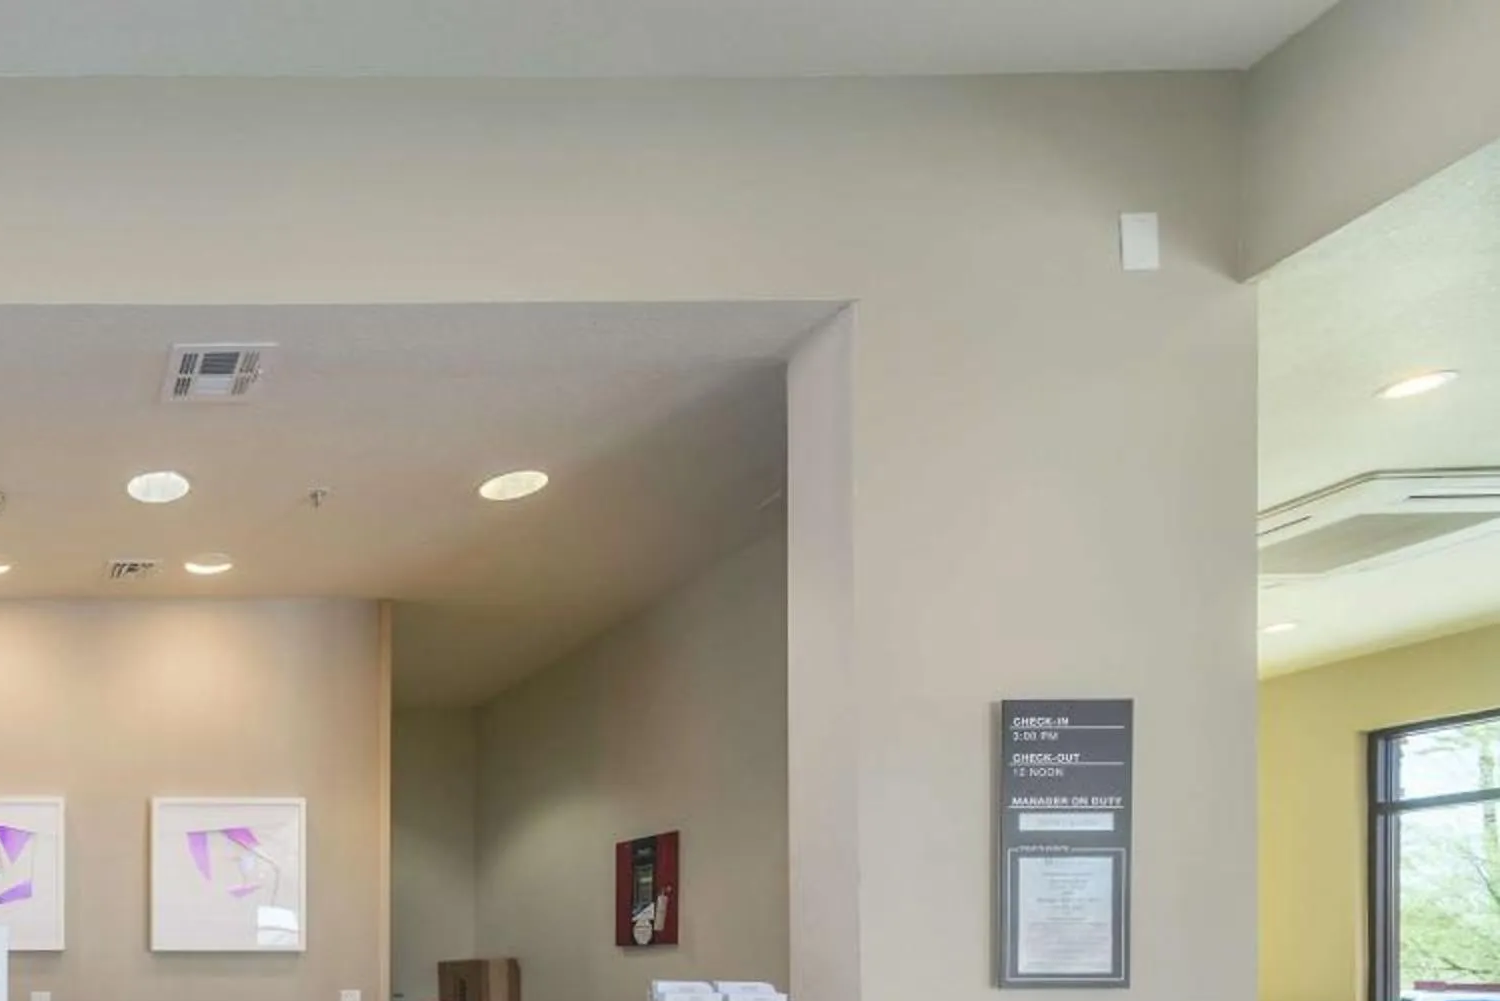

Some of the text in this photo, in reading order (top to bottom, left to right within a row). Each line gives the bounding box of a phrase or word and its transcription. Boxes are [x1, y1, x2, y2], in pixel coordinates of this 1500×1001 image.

[1012, 717, 1069, 727] CHECK-IN
[1040, 731, 1059, 740] PM
[1012, 753, 1080, 763] CHECK-OUT
[1029, 767, 1064, 776] NOON
[1012, 797, 1122, 806] MANAGER ON DUTY
